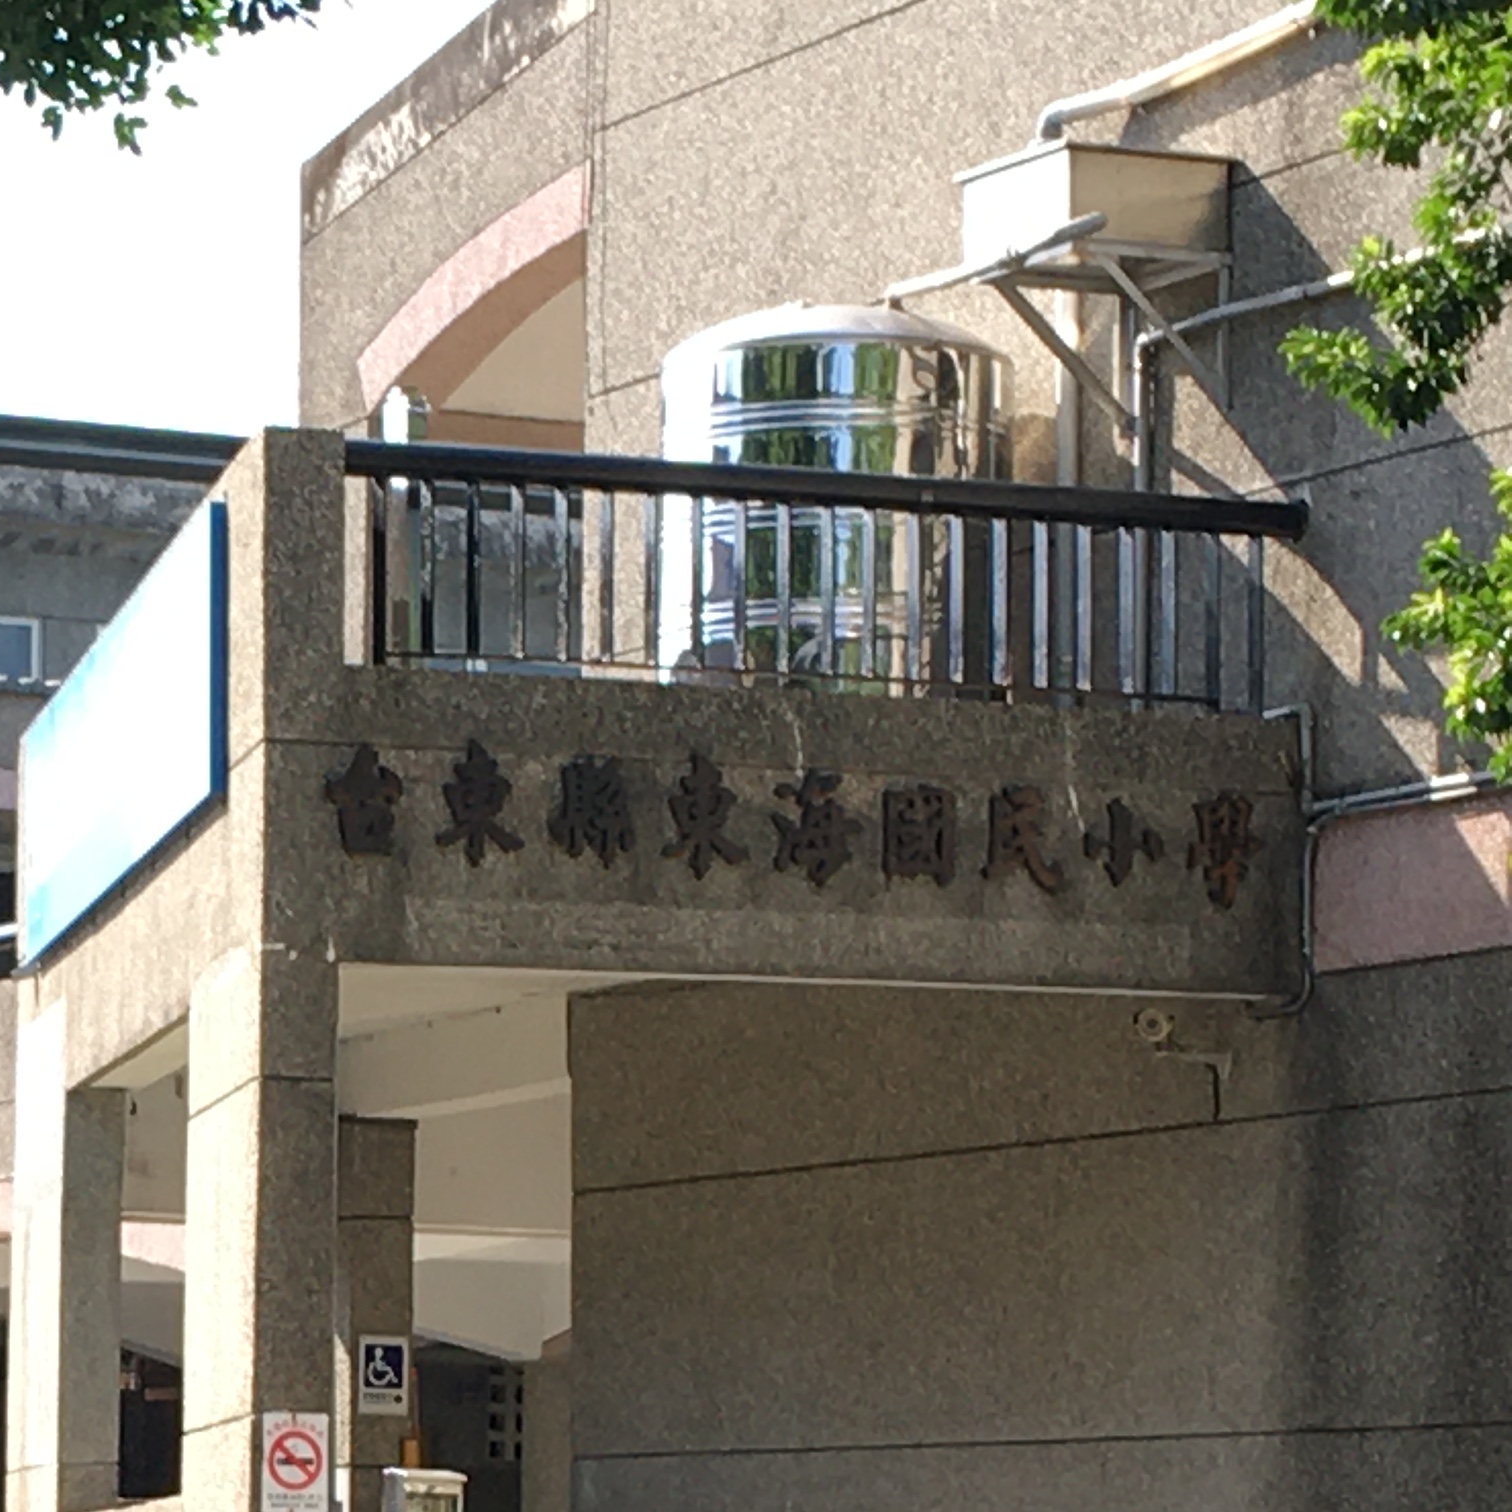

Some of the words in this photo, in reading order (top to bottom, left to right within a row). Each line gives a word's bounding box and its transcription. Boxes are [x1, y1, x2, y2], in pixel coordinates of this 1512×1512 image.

[326, 738, 1264, 911] 台東縣東海國民小學
